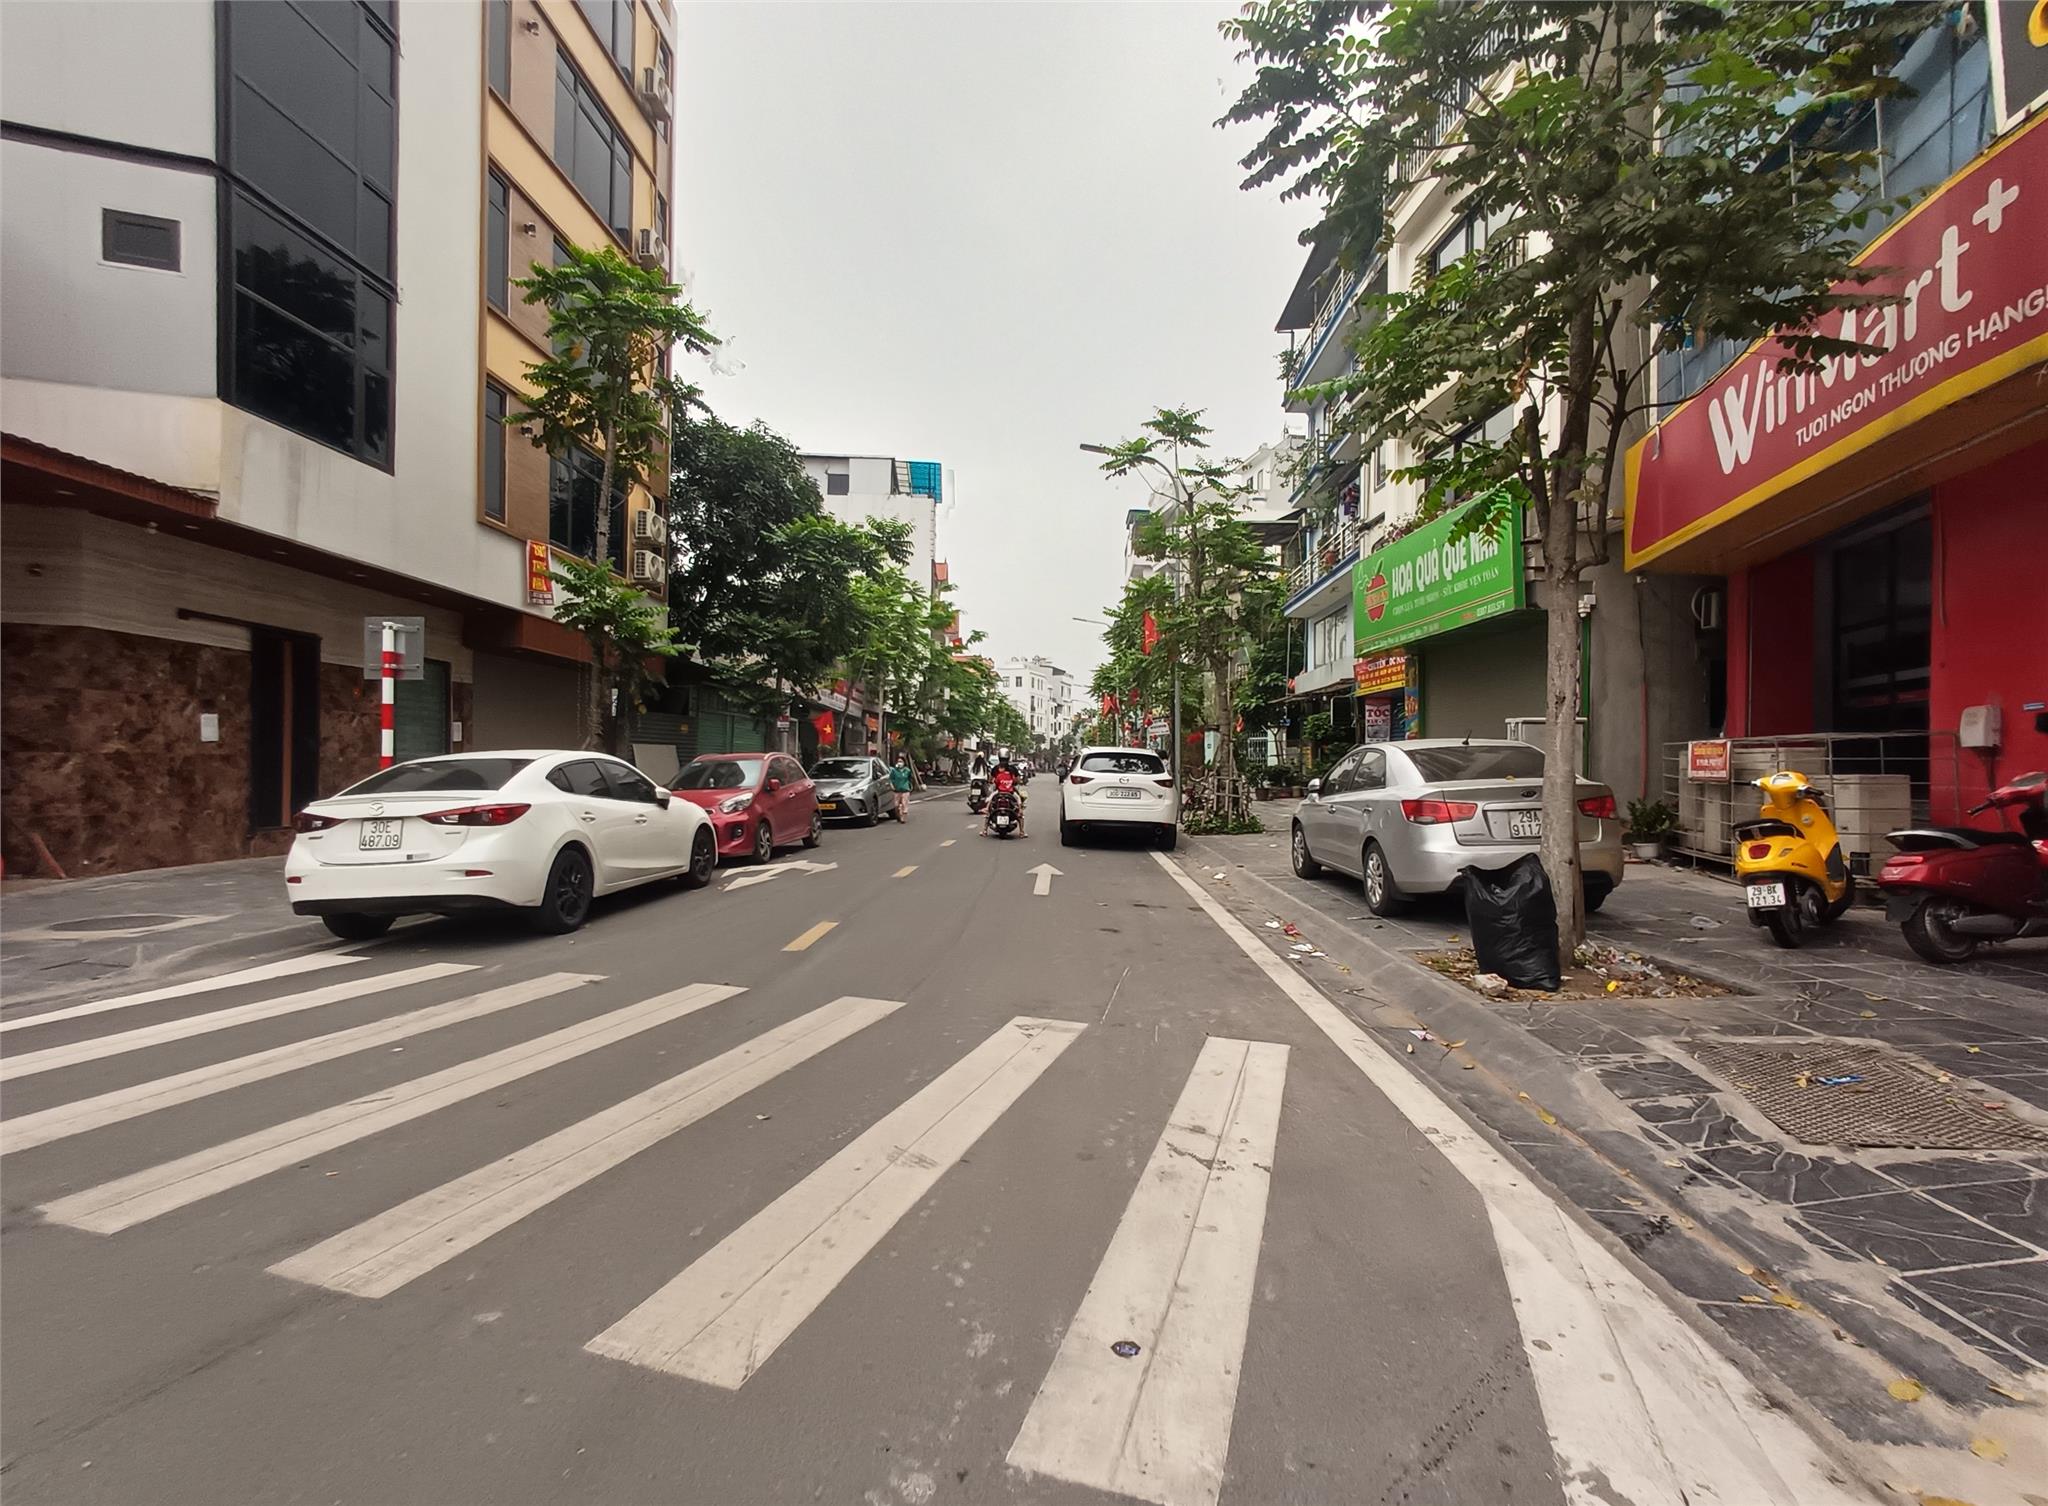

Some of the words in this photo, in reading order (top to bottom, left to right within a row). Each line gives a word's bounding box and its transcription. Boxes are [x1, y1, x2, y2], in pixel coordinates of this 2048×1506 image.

[1830, 383, 1876, 428] NGON
[1392, 560, 1412, 599] HOA
[1416, 539, 1439, 592] QUẢ
[1519, 811, 1541, 824] 29A
[370, 821, 393, 834] 30E
[361, 834, 400, 848] 487.09
